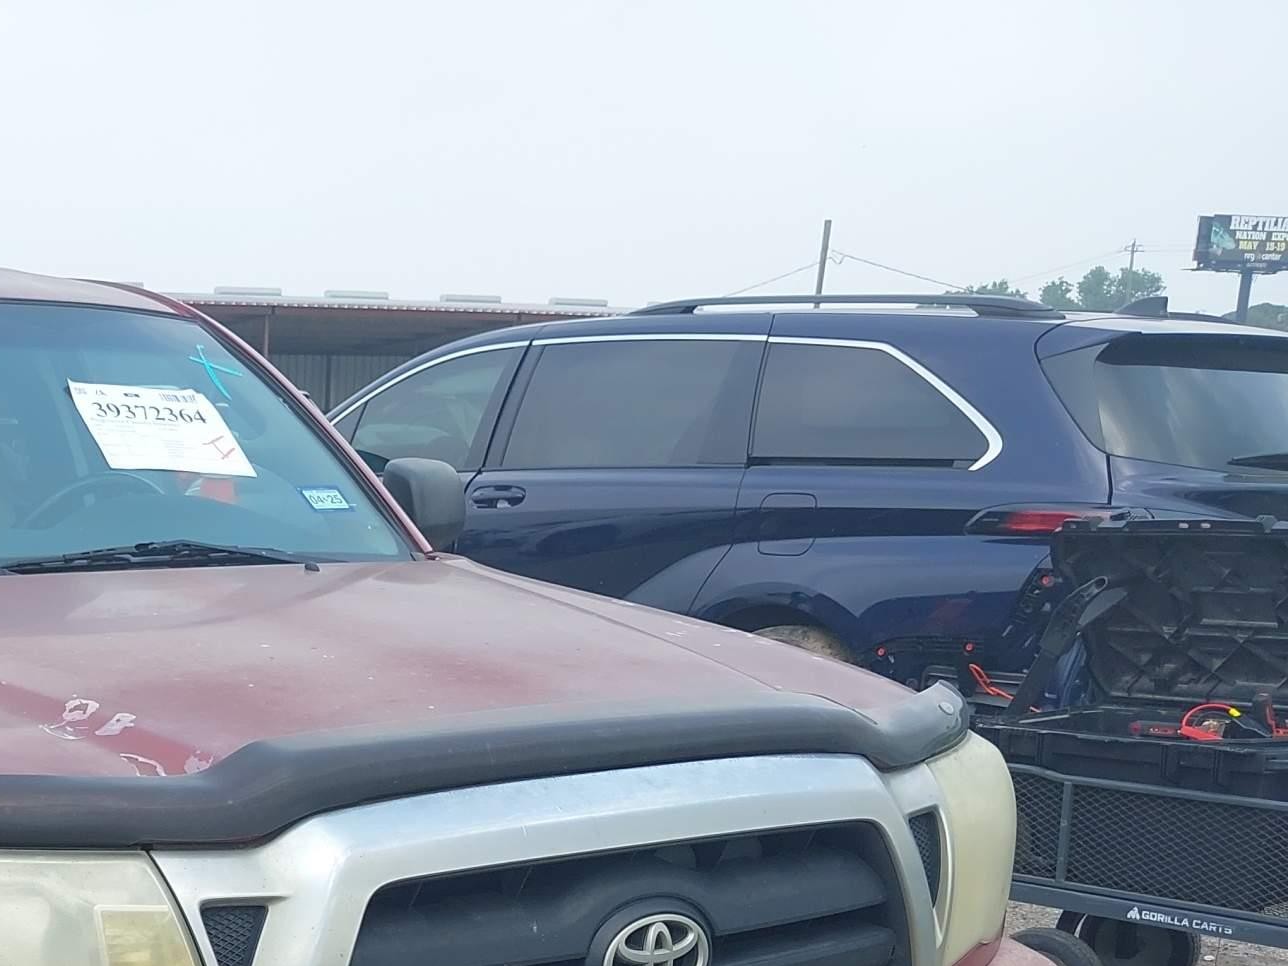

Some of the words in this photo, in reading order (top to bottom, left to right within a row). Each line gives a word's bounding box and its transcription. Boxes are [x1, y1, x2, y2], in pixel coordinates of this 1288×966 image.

[1235, 231, 1267, 241] NATION
[1239, 240, 1259, 250] MAY
[91, 401, 207, 424] 39372364
[1141, 910, 1190, 927] GORILLA
[1192, 919, 1233, 935] CARTS
